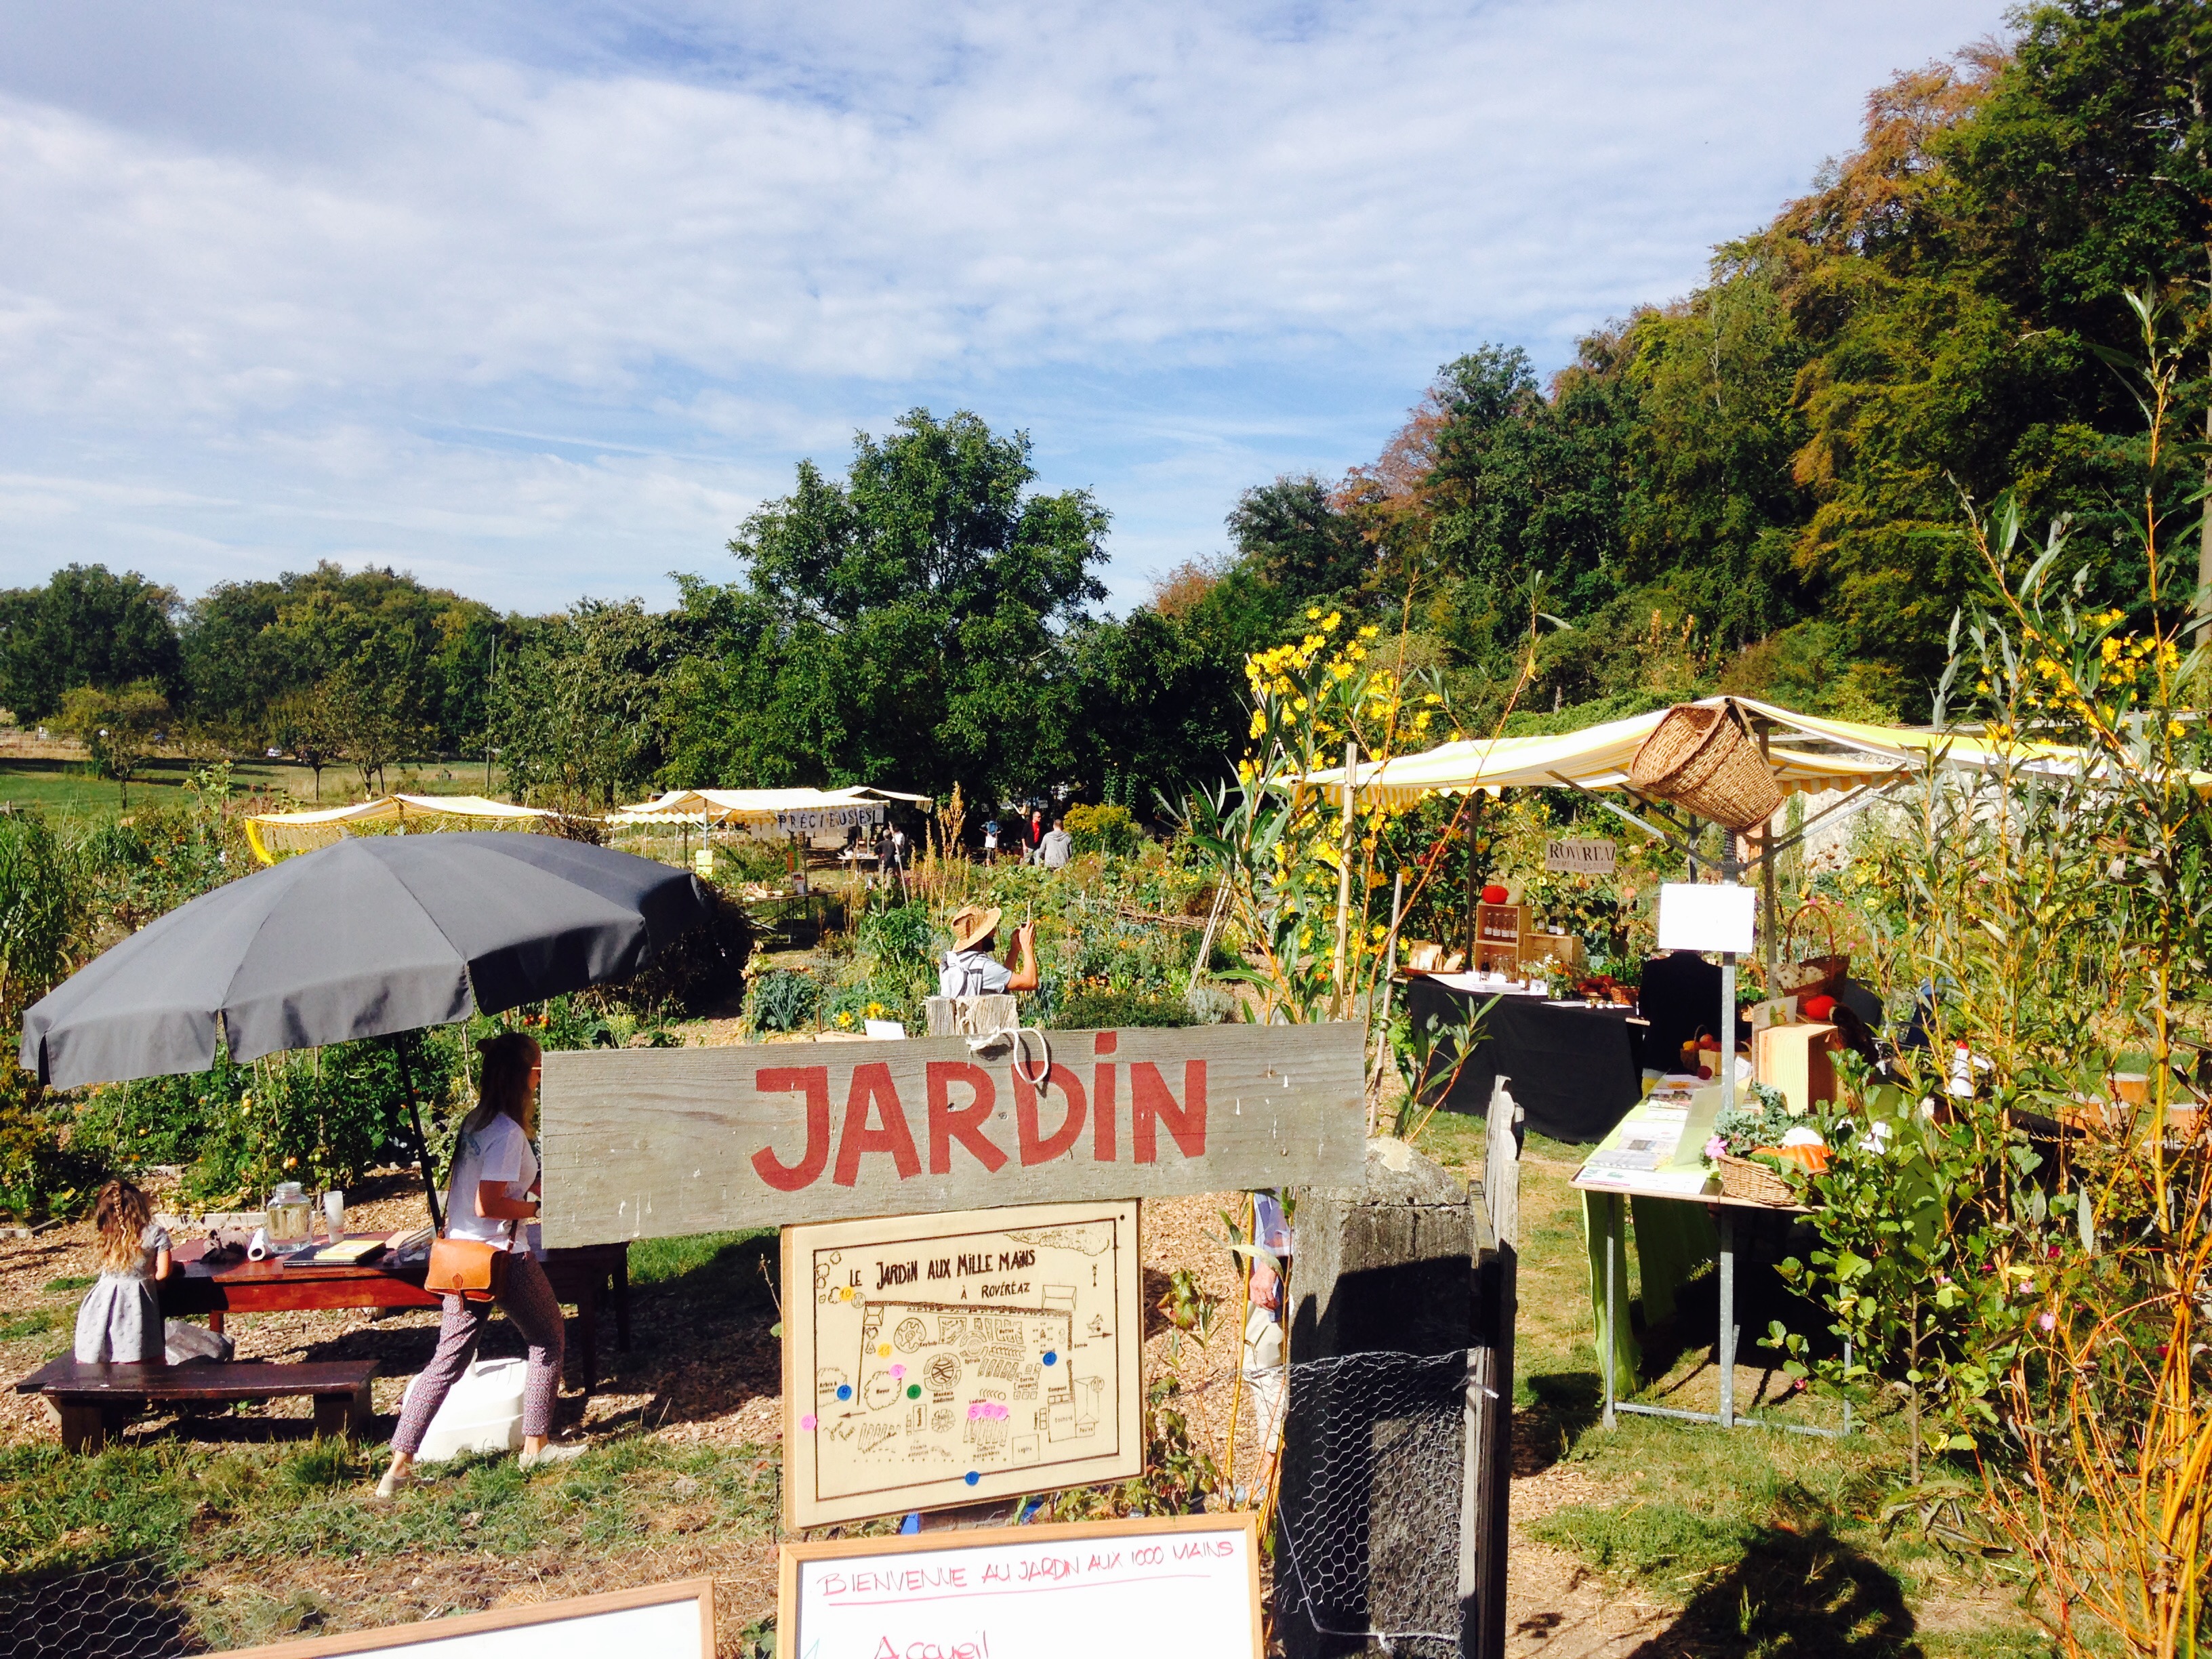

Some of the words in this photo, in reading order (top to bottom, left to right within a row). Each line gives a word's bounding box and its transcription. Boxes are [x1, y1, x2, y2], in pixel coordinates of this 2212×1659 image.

[849, 1269, 863, 1287] LE
[928, 1258, 951, 1279] AUX
[840, 1289, 851, 1298] 10
[961, 1285, 967, 1300] À
[981, 1280, 1031, 1298] ROVÉRÉAZ
[970, 1406, 977, 1418] 5
[984, 1405, 991, 1416] 6
[996, 1408, 1004, 1416] 7
[817, 1567, 968, 1596] BIENVENUE
[982, 1563, 1011, 1584] AU
[1019, 1556, 1080, 1583] JARDIN
[1087, 1549, 1122, 1574] AUX
[1131, 1547, 1164, 1567] 1000
[1174, 1541, 1235, 1560] MAINS
